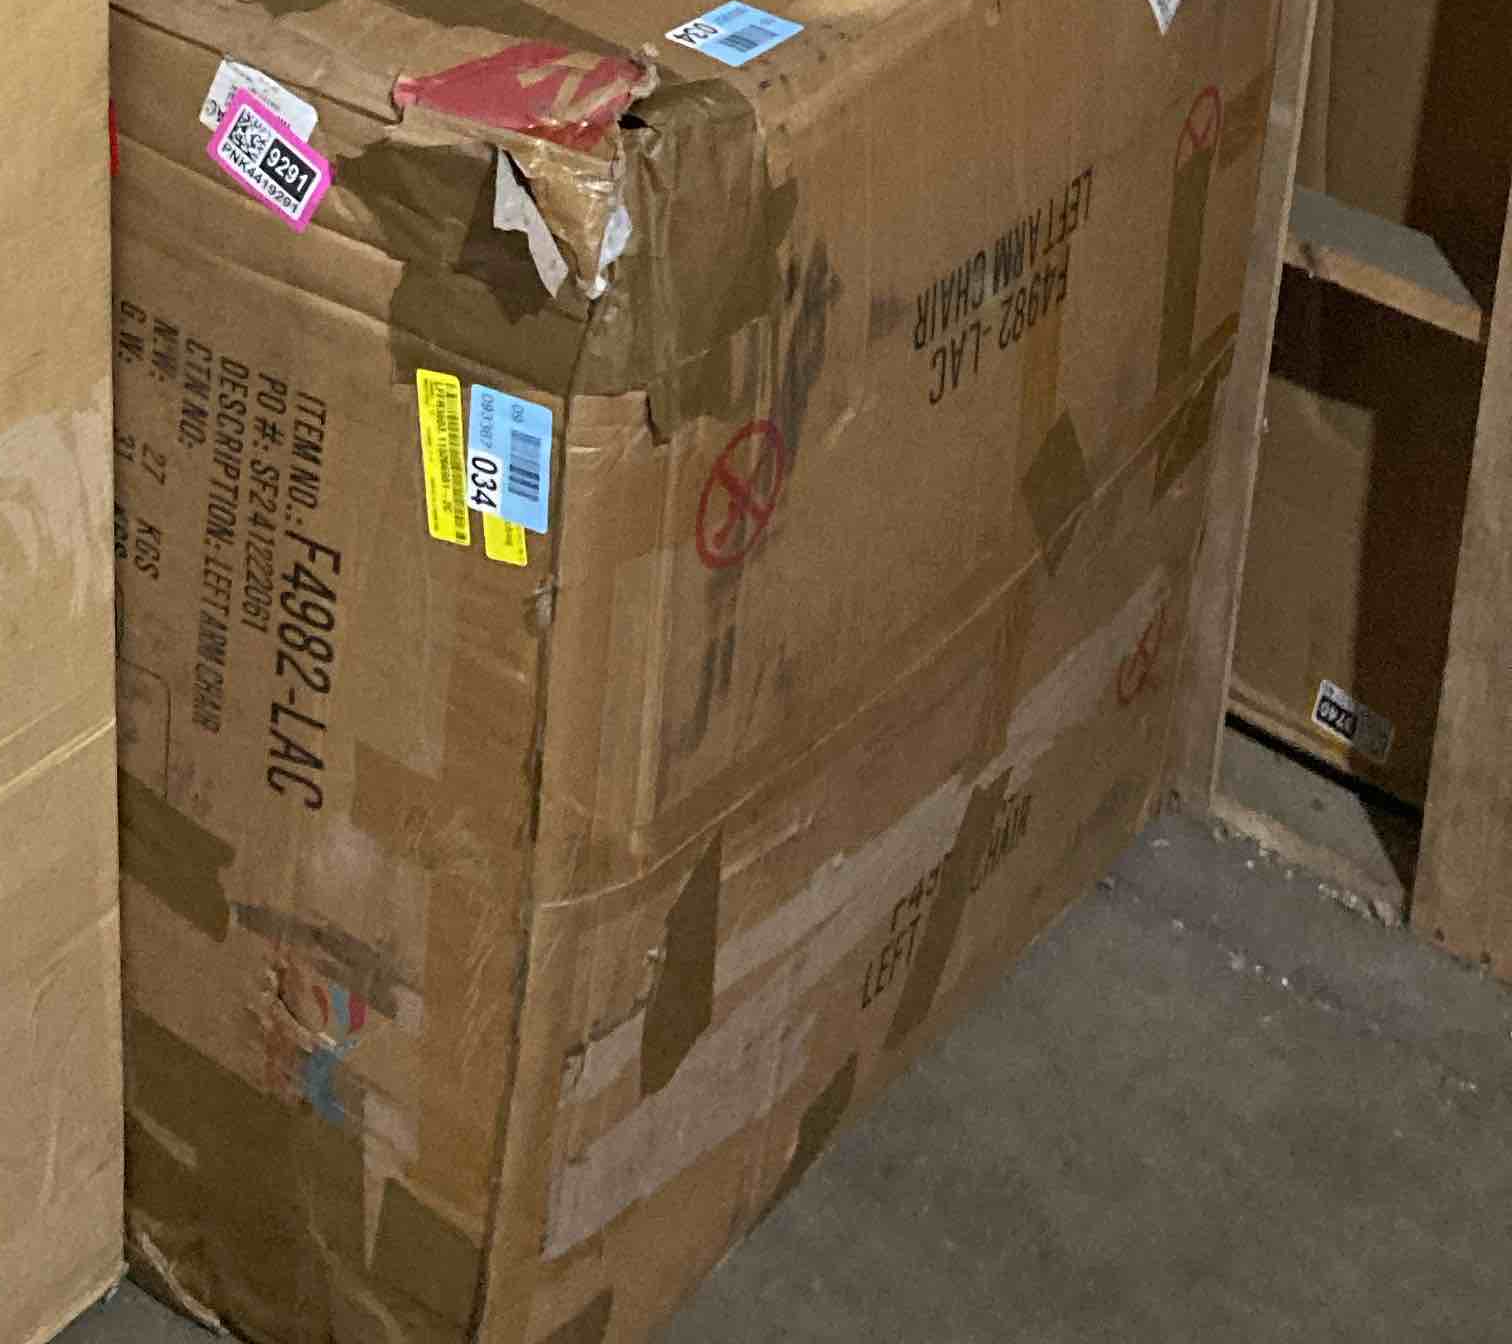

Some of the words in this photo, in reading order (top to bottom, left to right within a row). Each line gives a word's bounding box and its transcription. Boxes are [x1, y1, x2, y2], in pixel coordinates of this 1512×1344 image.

[673, 22, 719, 44] 034
[266, 147, 310, 193] 9291
[1043, 167, 1094, 256] LEFT
[992, 208, 1041, 297] ARM
[913, 249, 987, 351] CHAIR
[183, 337, 213, 393] CTN
[256, 372, 287, 413] PO
[203, 355, 249, 549] DESCRIPTION:
[290, 390, 327, 463] ITEM
[140, 443, 167, 487] 27
[471, 456, 498, 510] 034
[133, 517, 163, 582] KGS
[240, 459, 279, 633] SF241222061
[201, 555, 232, 614] LEFT
[198, 611, 227, 663] ARM
[264, 529, 342, 812] F4982-LAC
[192, 662, 224, 734] CHAIR
[861, 913, 921, 1009] LEFT
